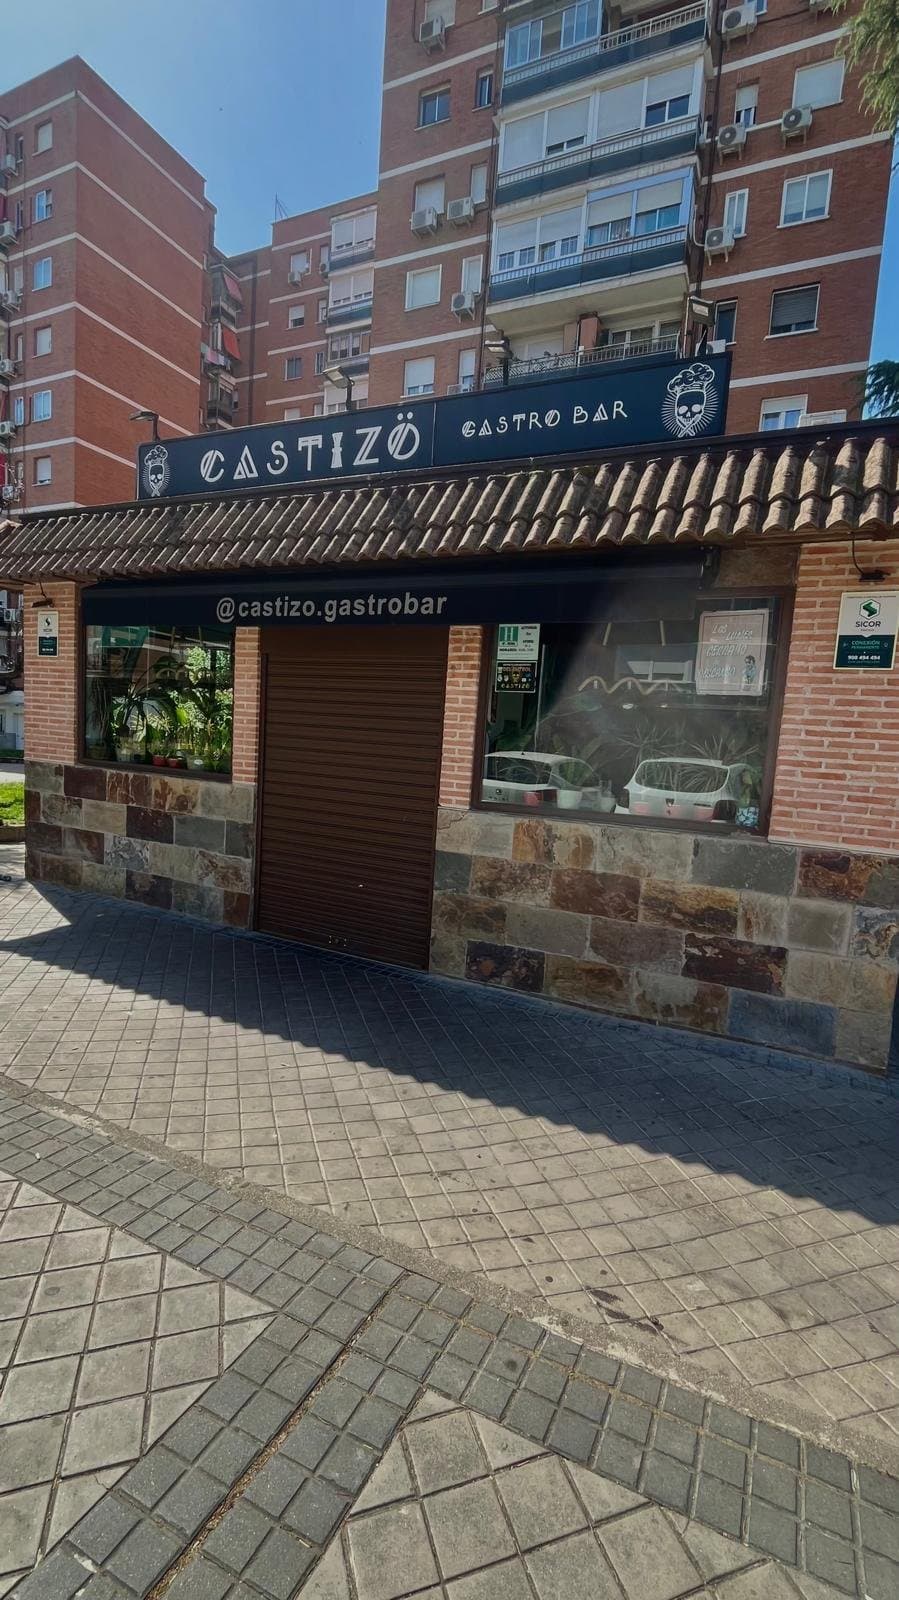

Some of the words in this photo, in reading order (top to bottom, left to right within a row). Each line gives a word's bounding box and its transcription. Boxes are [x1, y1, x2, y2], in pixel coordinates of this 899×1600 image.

[462, 409, 561, 437] GASTRO
[573, 400, 628, 425] BAR
[200, 411, 420, 482] CASTIZÖ
[216, 592, 447, 623] @castizo.gastrobar
[855, 620, 881, 628] SICOR
